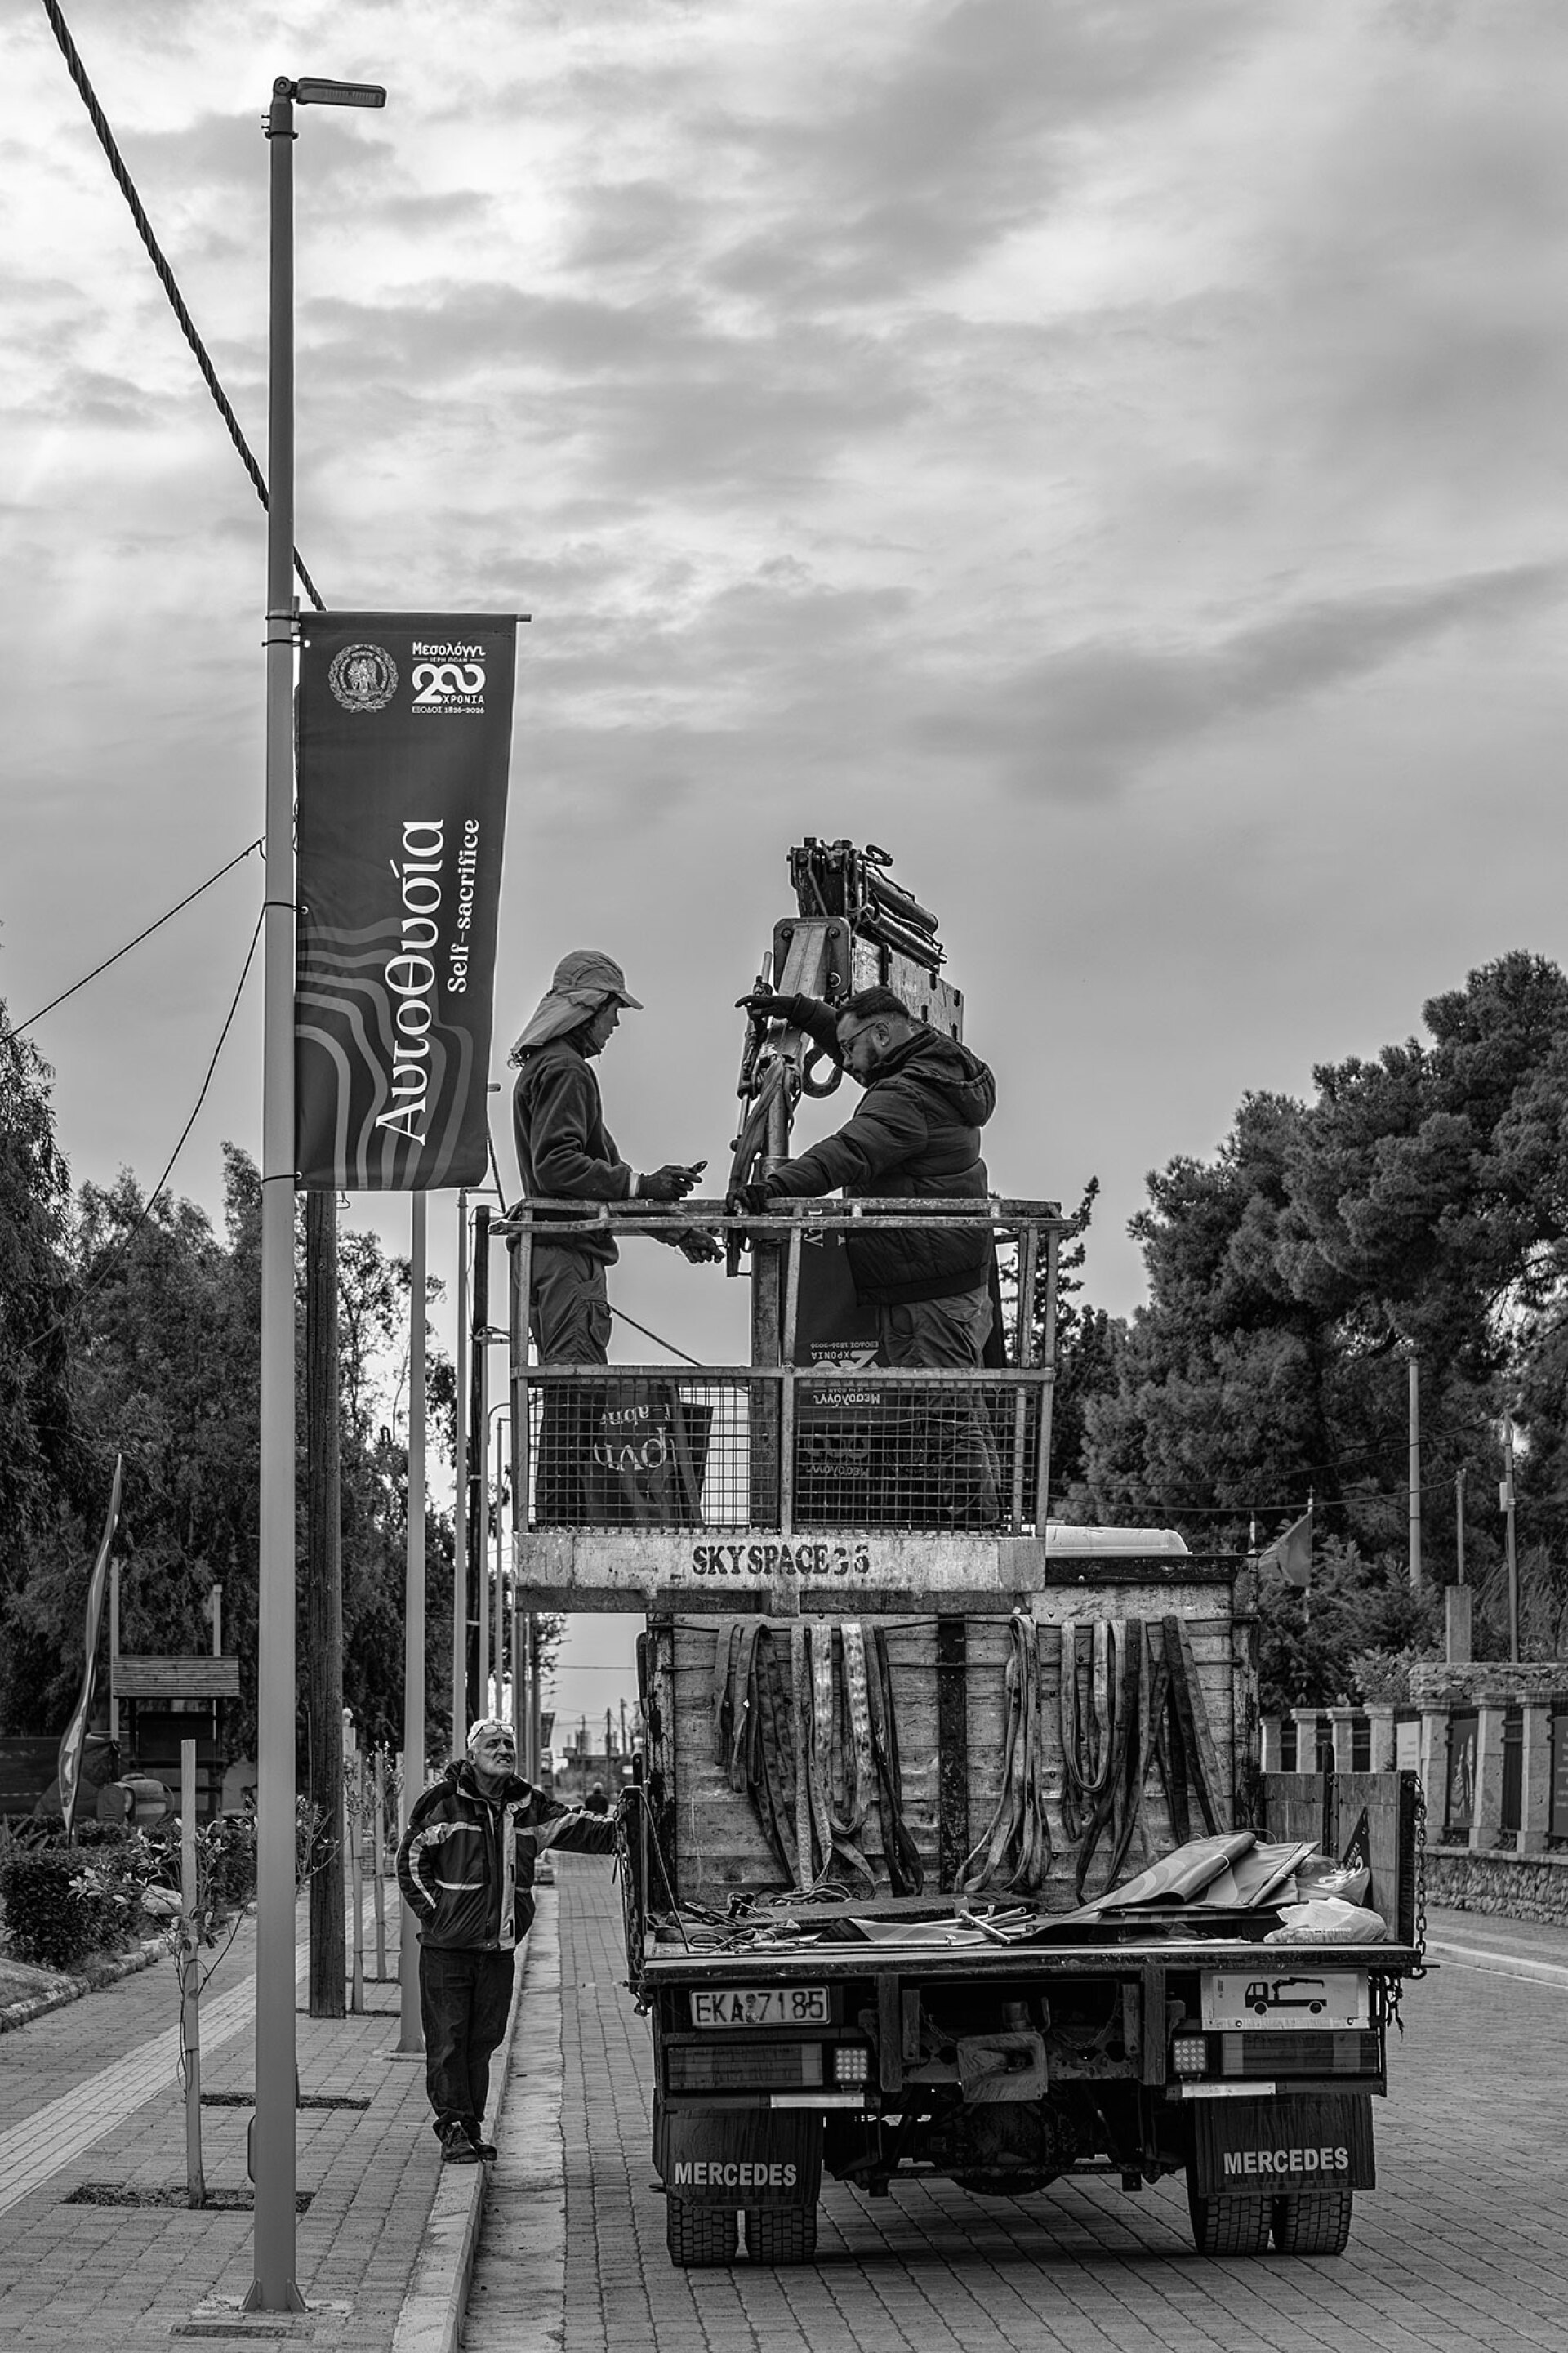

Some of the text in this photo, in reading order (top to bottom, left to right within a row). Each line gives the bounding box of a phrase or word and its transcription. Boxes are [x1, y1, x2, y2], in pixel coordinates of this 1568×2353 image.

[412, 641, 486, 657] Μεσολόγγι
[443, 695, 484, 704] ΧΡΟΝΙΑ
[448, 819, 479, 993] Self-sacrifice
[376, 819, 445, 1146] Αυτοθυσία
[758, 1991, 824, 2021] 7185
[675, 2162, 797, 2186] MERCEDES
[1223, 2147, 1349, 2175] MERCEDES
